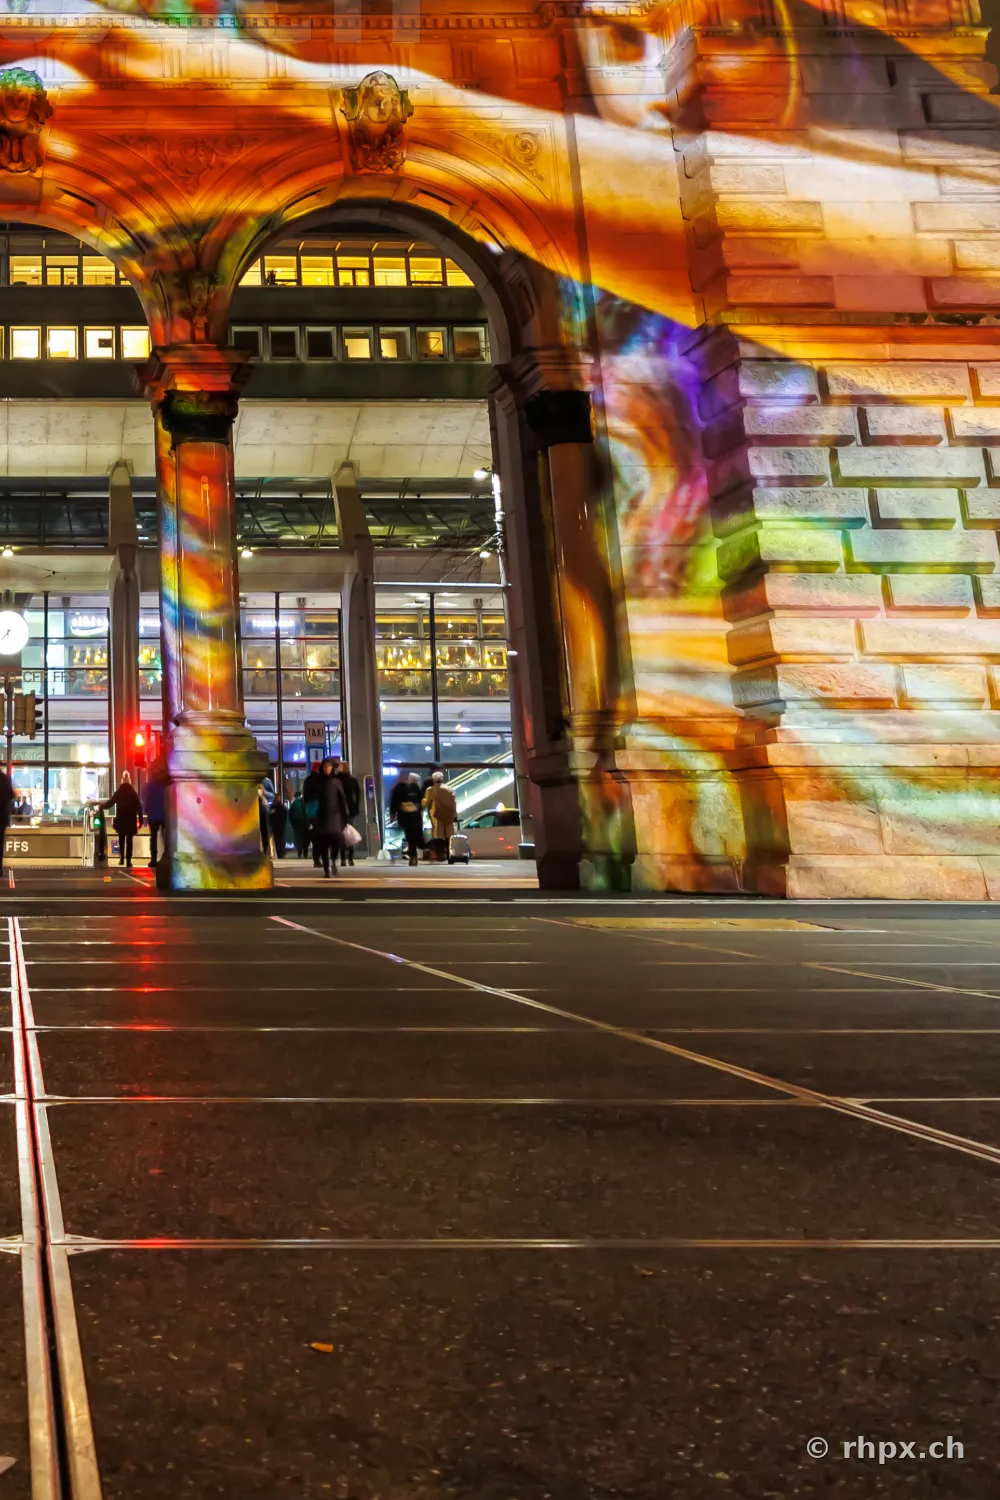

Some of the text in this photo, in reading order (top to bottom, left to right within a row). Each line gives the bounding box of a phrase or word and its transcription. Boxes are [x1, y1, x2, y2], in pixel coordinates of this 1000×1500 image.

[53, 671, 78, 683] FFS
[307, 727, 324, 737] TAXI
[5, 840, 29, 852] FFS
